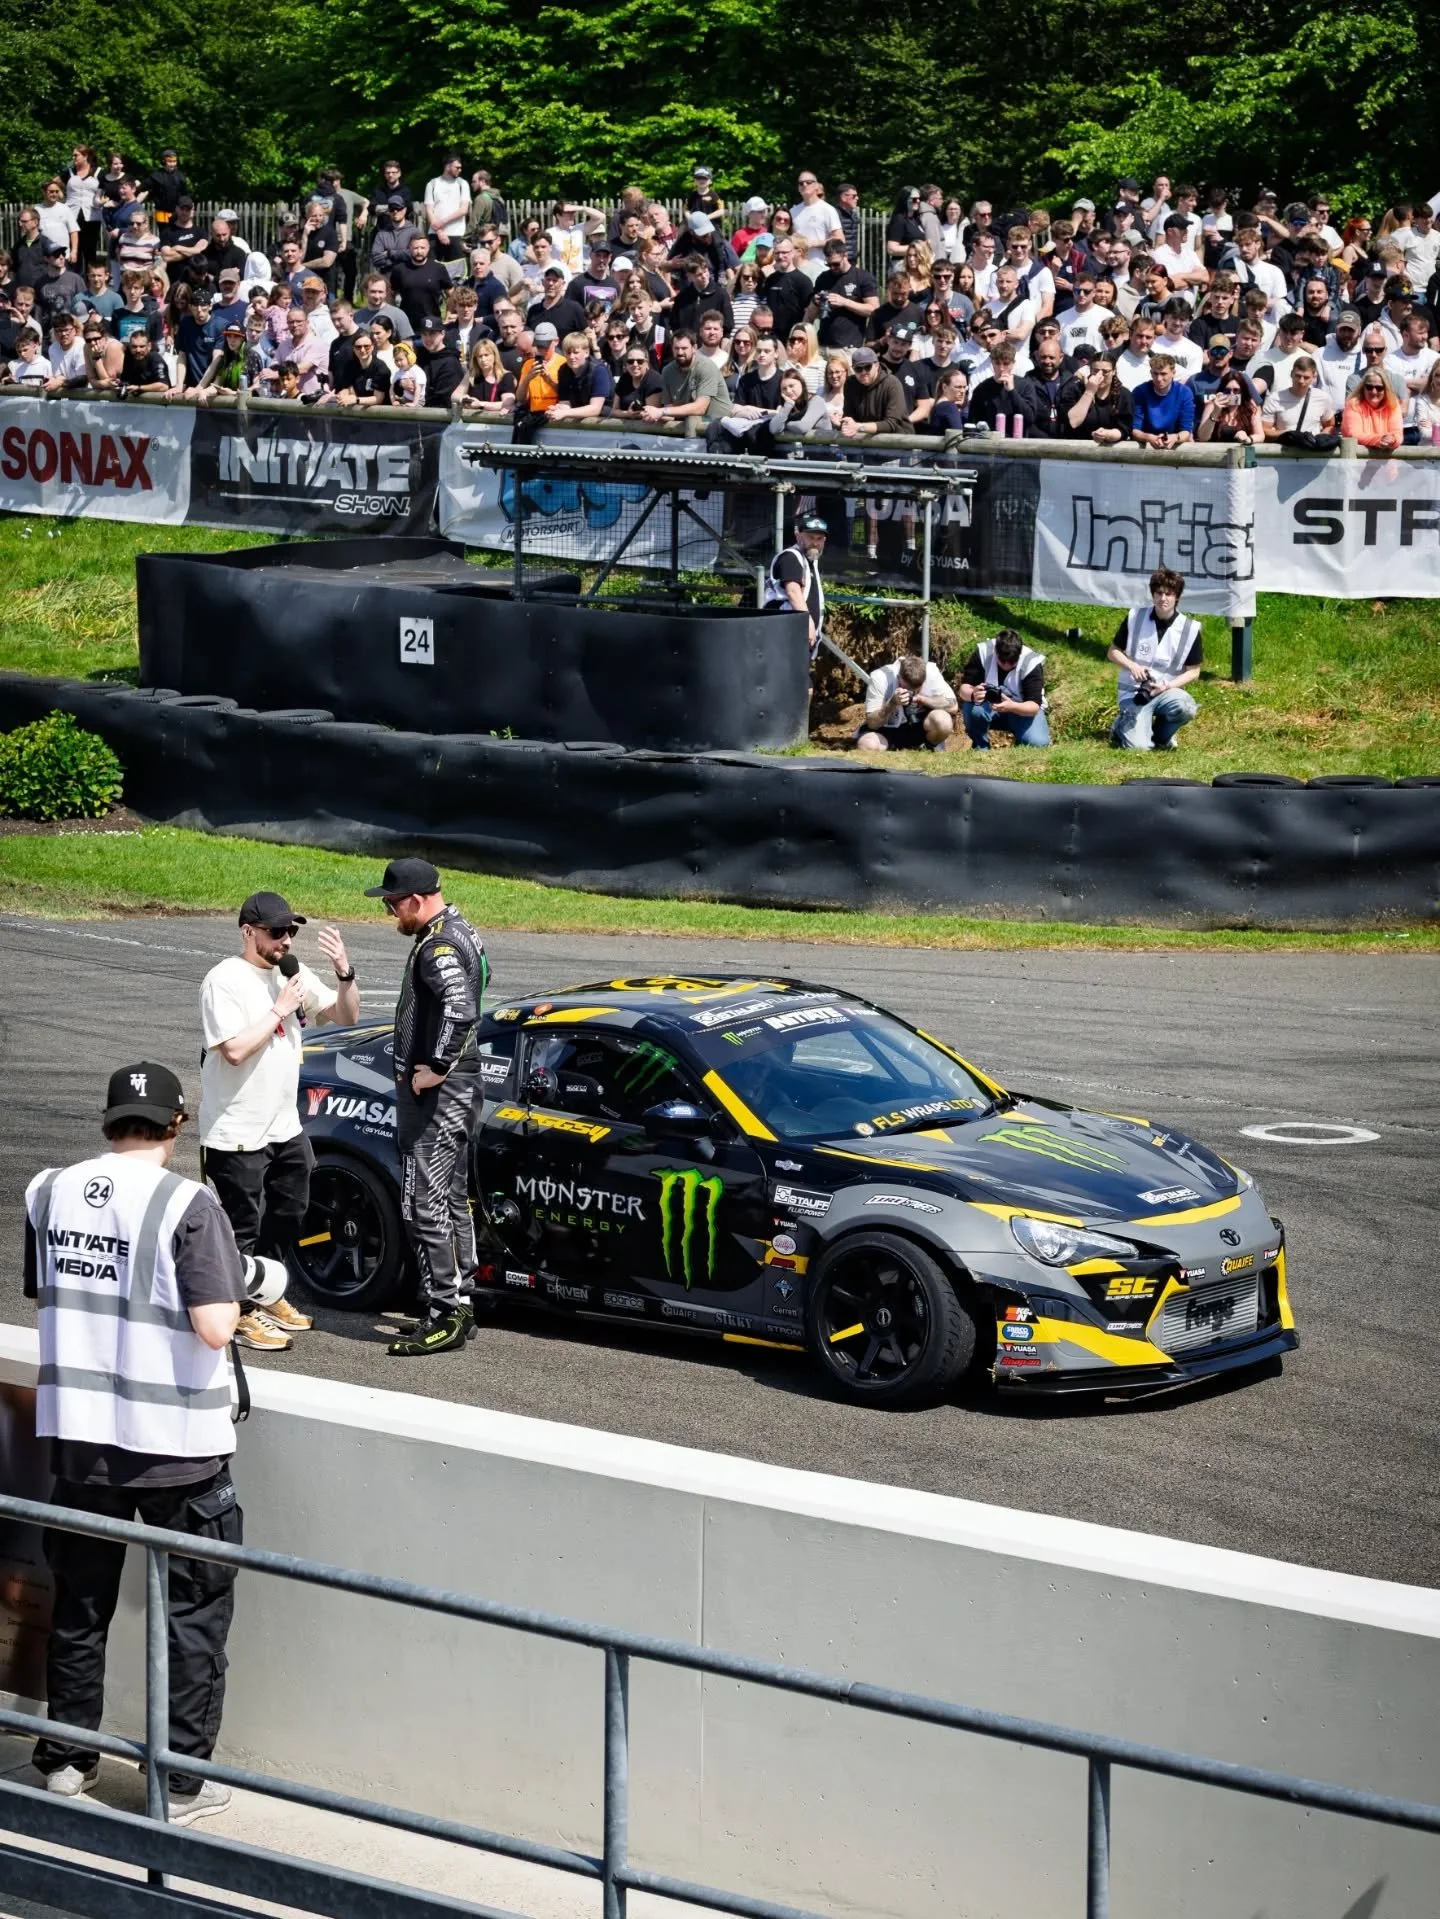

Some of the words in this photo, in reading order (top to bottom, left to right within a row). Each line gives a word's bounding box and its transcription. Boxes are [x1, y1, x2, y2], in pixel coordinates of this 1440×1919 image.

[2, 426, 153, 490] SONAX
[219, 436, 410, 492] INITIATE
[1067, 495, 1255, 581] Initia
[404, 629, 430, 653] 24
[326, 1096, 397, 1127] YUASA
[872, 1111, 906, 1130] FLS
[900, 1101, 951, 1119] WRAPS
[949, 1098, 972, 1110] LTD
[86, 1182, 110, 1201] 24
[515, 1176, 646, 1221] MONSTER
[789, 1195, 830, 1210] STAUFF
[535, 1208, 627, 1234] ENERGY
[48, 1229, 129, 1257] INITIATE
[55, 1257, 118, 1281] MEDIA
[1187, 1268, 1206, 1278] YUASA
[1226, 1255, 1254, 1273] QUAIFE
[547, 1284, 588, 1299] DRIVEN
